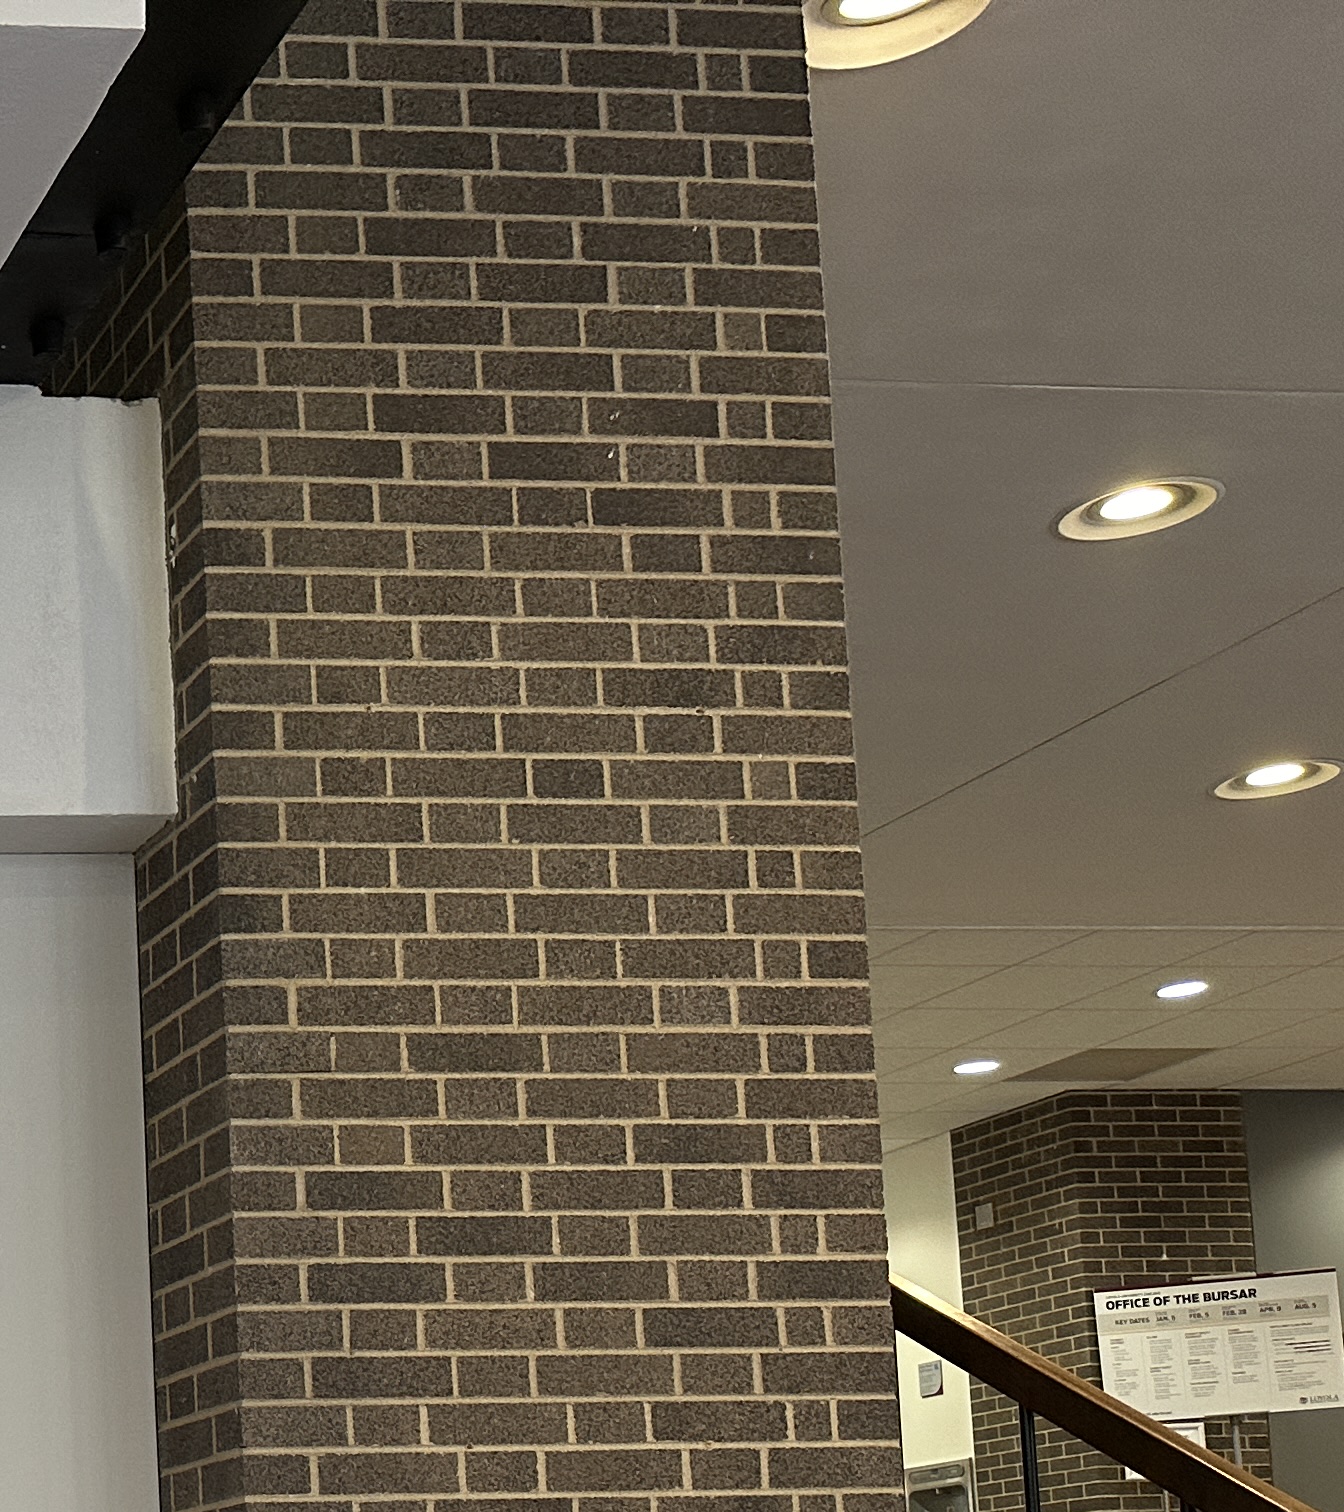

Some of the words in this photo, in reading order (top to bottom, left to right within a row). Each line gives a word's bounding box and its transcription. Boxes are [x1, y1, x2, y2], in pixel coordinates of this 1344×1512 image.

[1105, 1297, 1150, 1311] OFFICE
[1153, 1296, 1171, 1307] OF
[1173, 1293, 1200, 1305] THE
[1203, 1288, 1257, 1303] BURSAR
